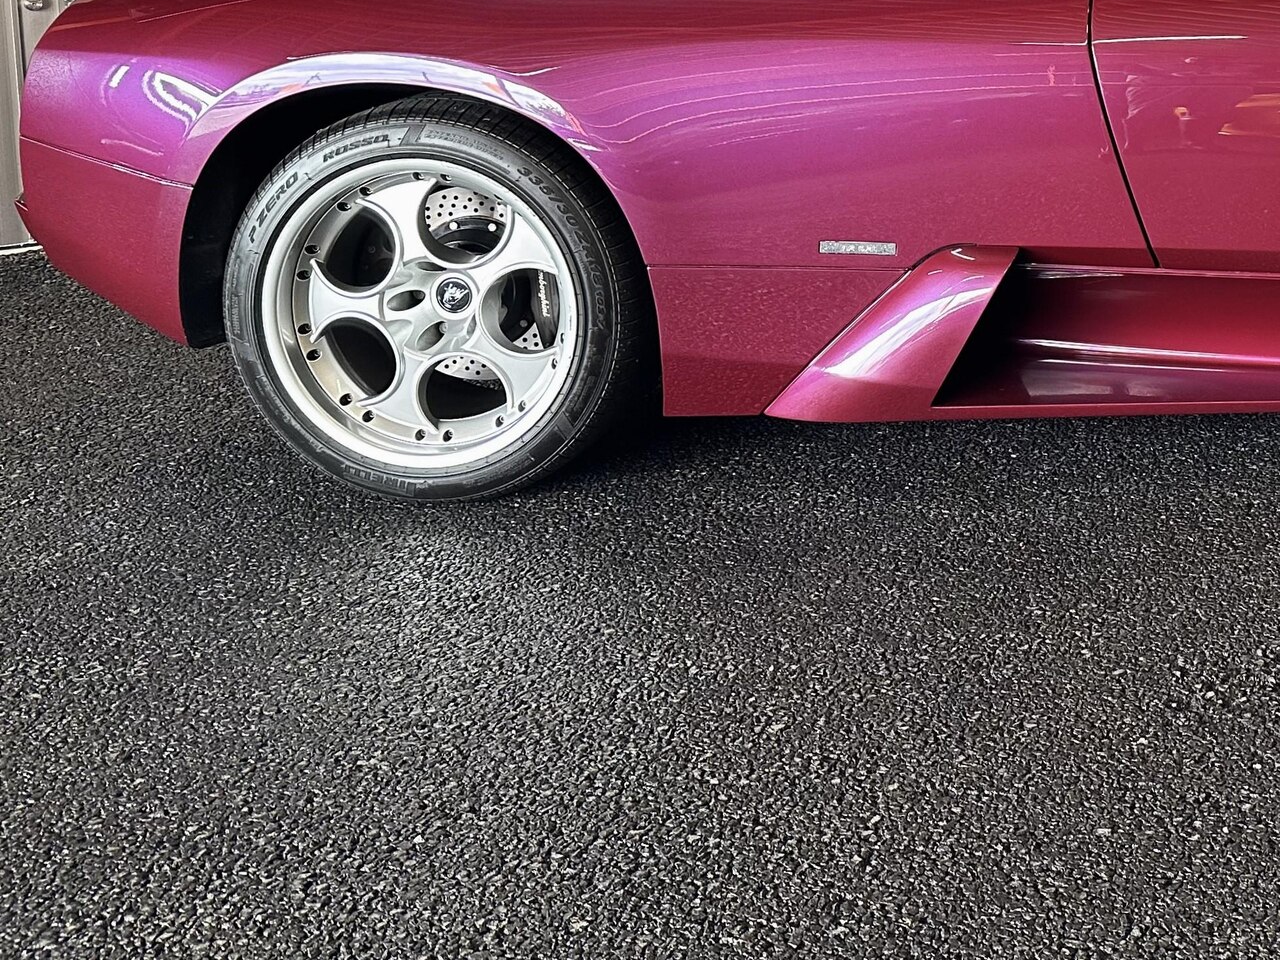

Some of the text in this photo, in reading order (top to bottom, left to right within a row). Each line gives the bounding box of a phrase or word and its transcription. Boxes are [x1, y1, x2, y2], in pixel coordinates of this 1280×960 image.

[248, 225, 257, 243] P
[256, 172, 298, 227] ZERO
[323, 134, 390, 163] ROSSO
